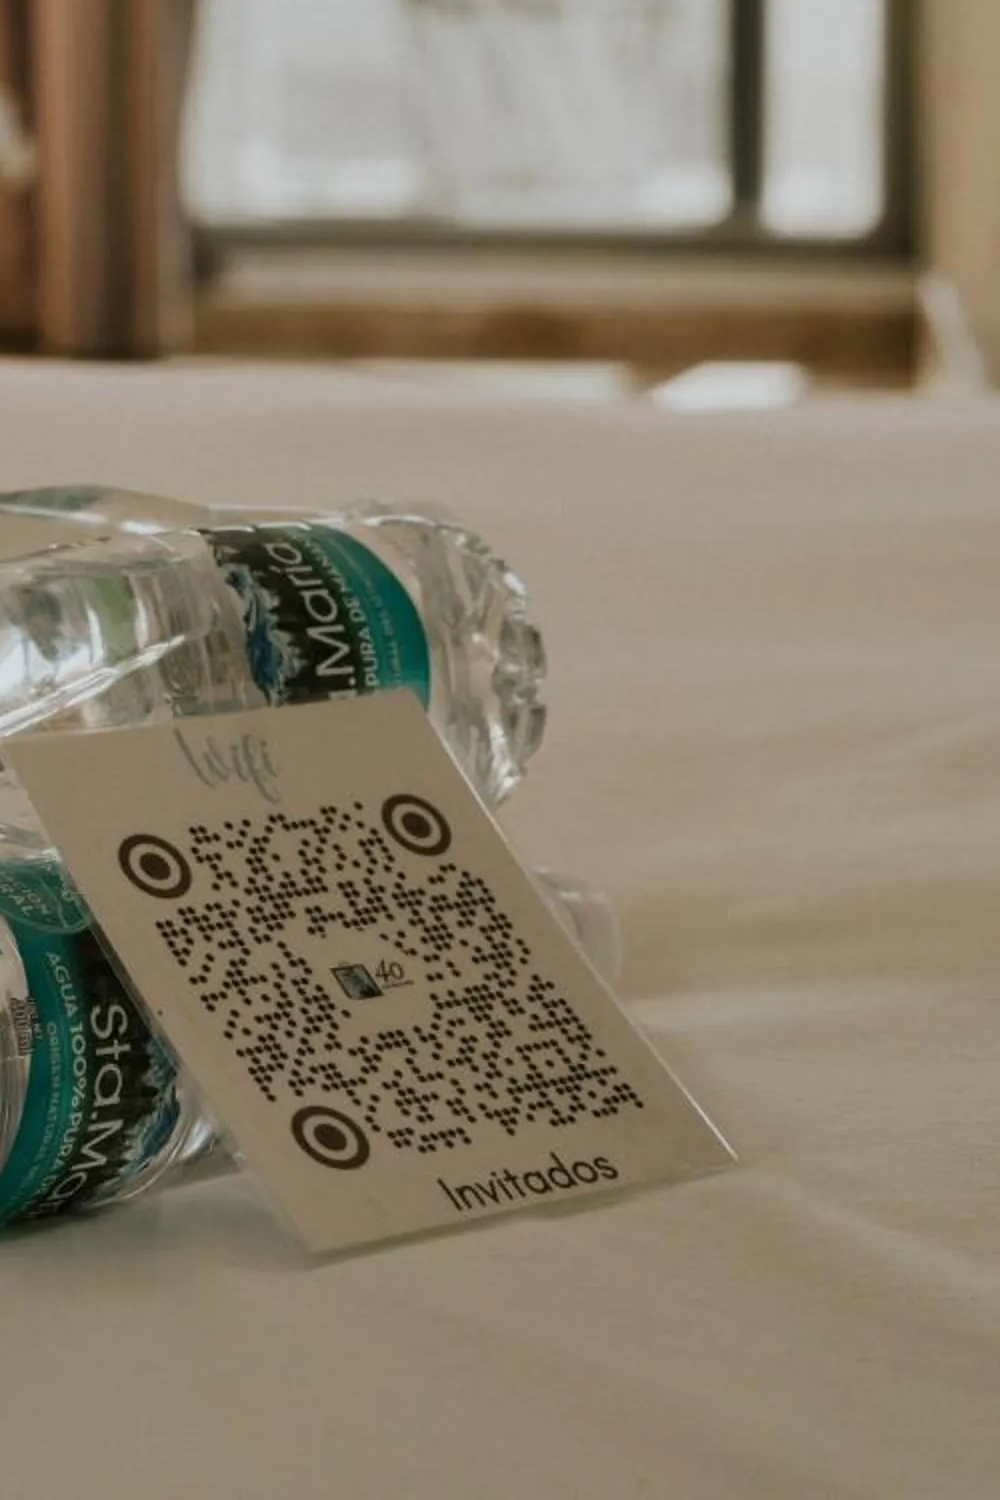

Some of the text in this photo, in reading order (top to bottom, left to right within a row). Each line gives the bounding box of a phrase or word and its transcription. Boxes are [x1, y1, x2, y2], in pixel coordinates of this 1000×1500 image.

[357, 626, 381, 687] PURA
[46, 952, 79, 1018] AGUA
[69, 1021, 87, 1109] 100%
[51, 1112, 83, 1171] PURA
[437, 1151, 619, 1211] Invitados
